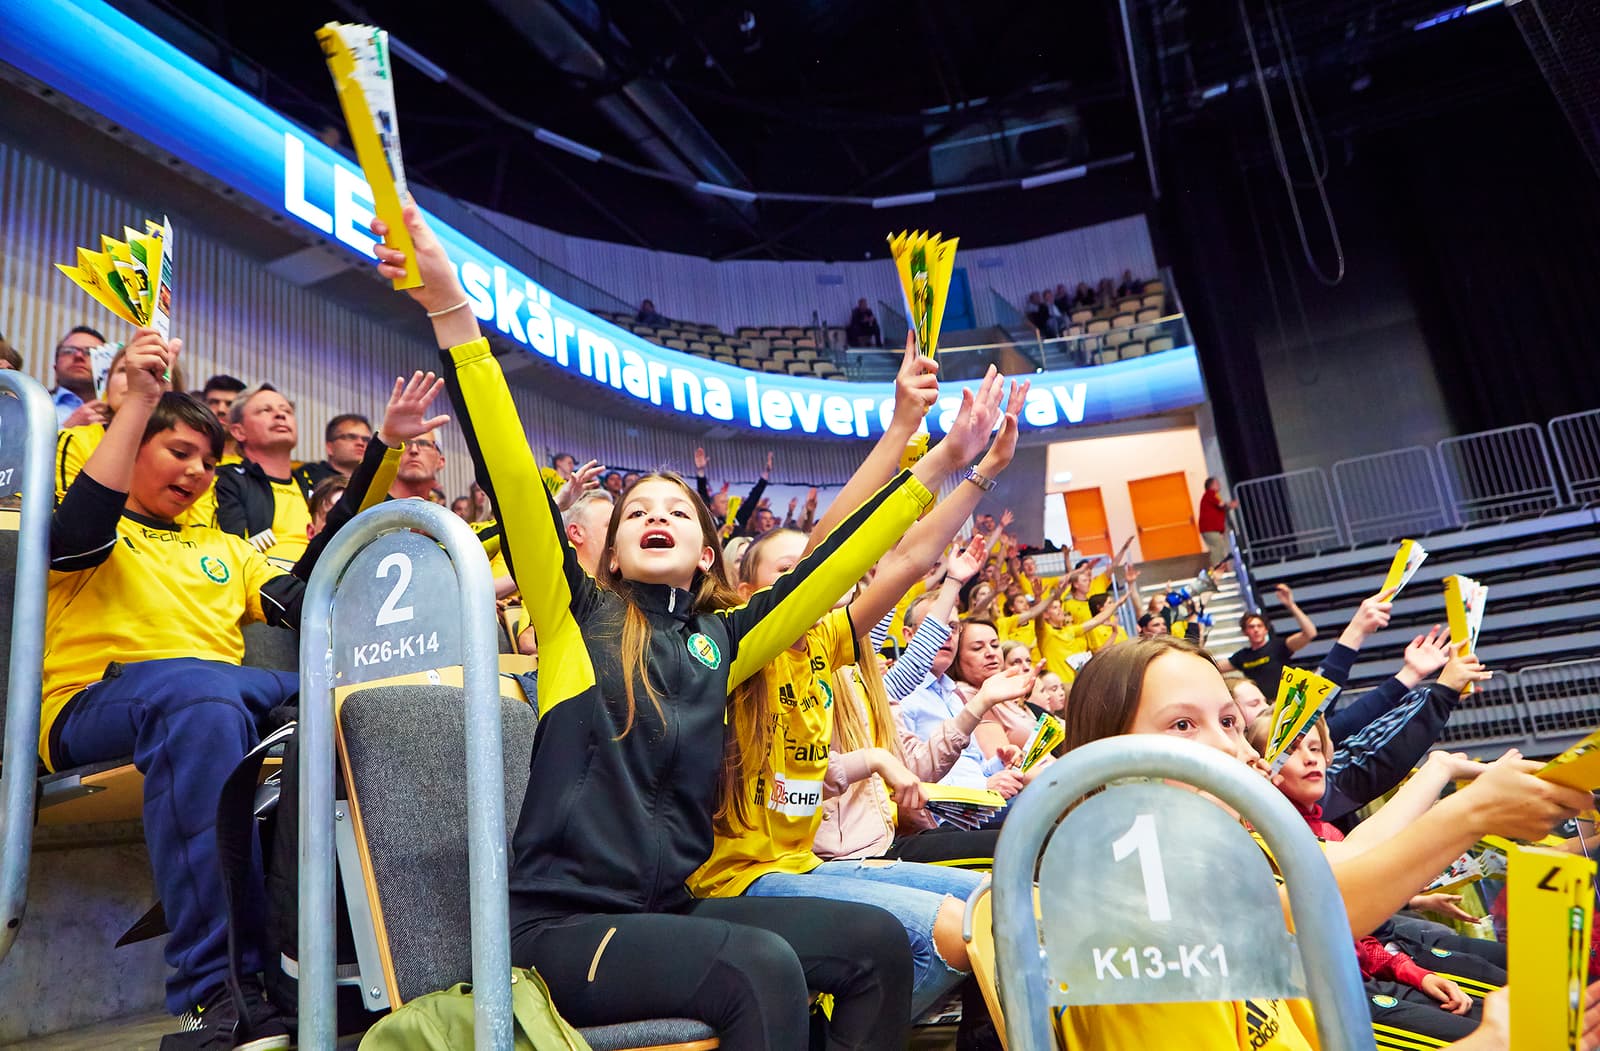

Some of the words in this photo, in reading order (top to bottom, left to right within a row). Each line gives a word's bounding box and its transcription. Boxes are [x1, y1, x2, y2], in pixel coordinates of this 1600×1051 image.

[745, 375, 1005, 437] levera
[1025, 383, 1087, 427] av
[375, 552, 414, 627] 2
[353, 631, 440, 668] K26-K14
[1112, 813, 1172, 922] 1
[1092, 943, 1230, 980] K13-K1
